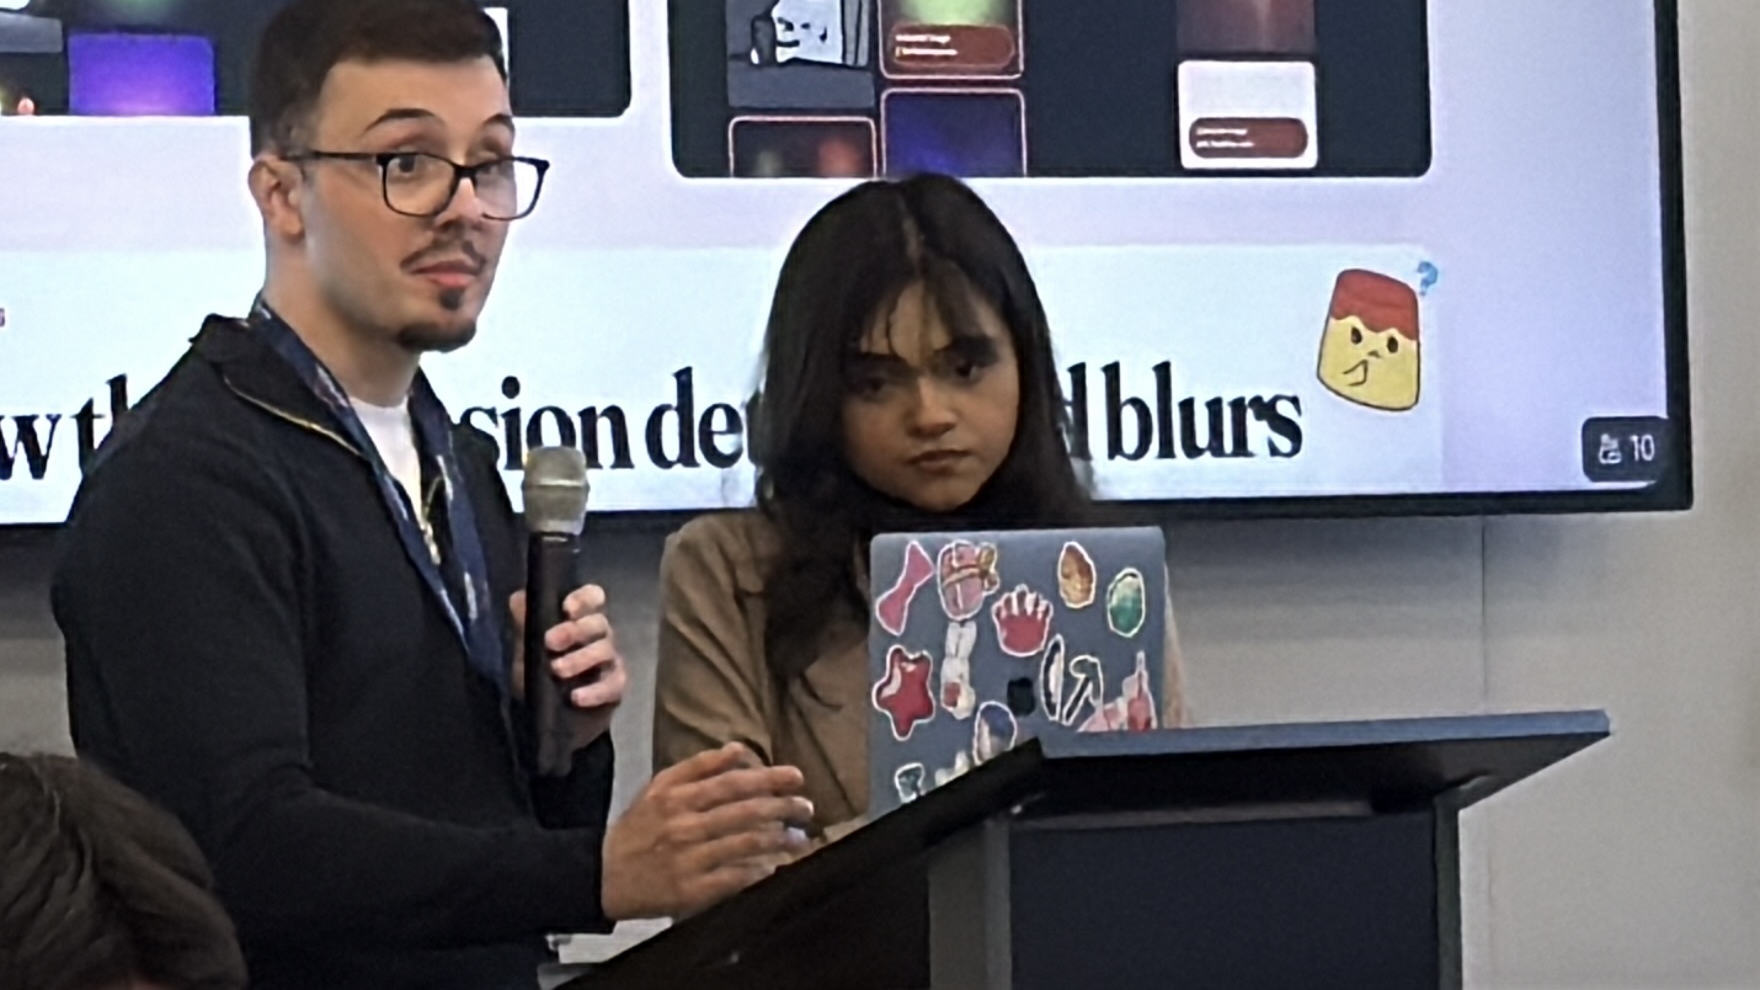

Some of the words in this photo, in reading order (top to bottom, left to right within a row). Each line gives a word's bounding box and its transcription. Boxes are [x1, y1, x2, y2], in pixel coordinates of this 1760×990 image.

[644, 365, 744, 470] de
[1099, 358, 1304, 462] blurs
[1628, 433, 1656, 463] 10
